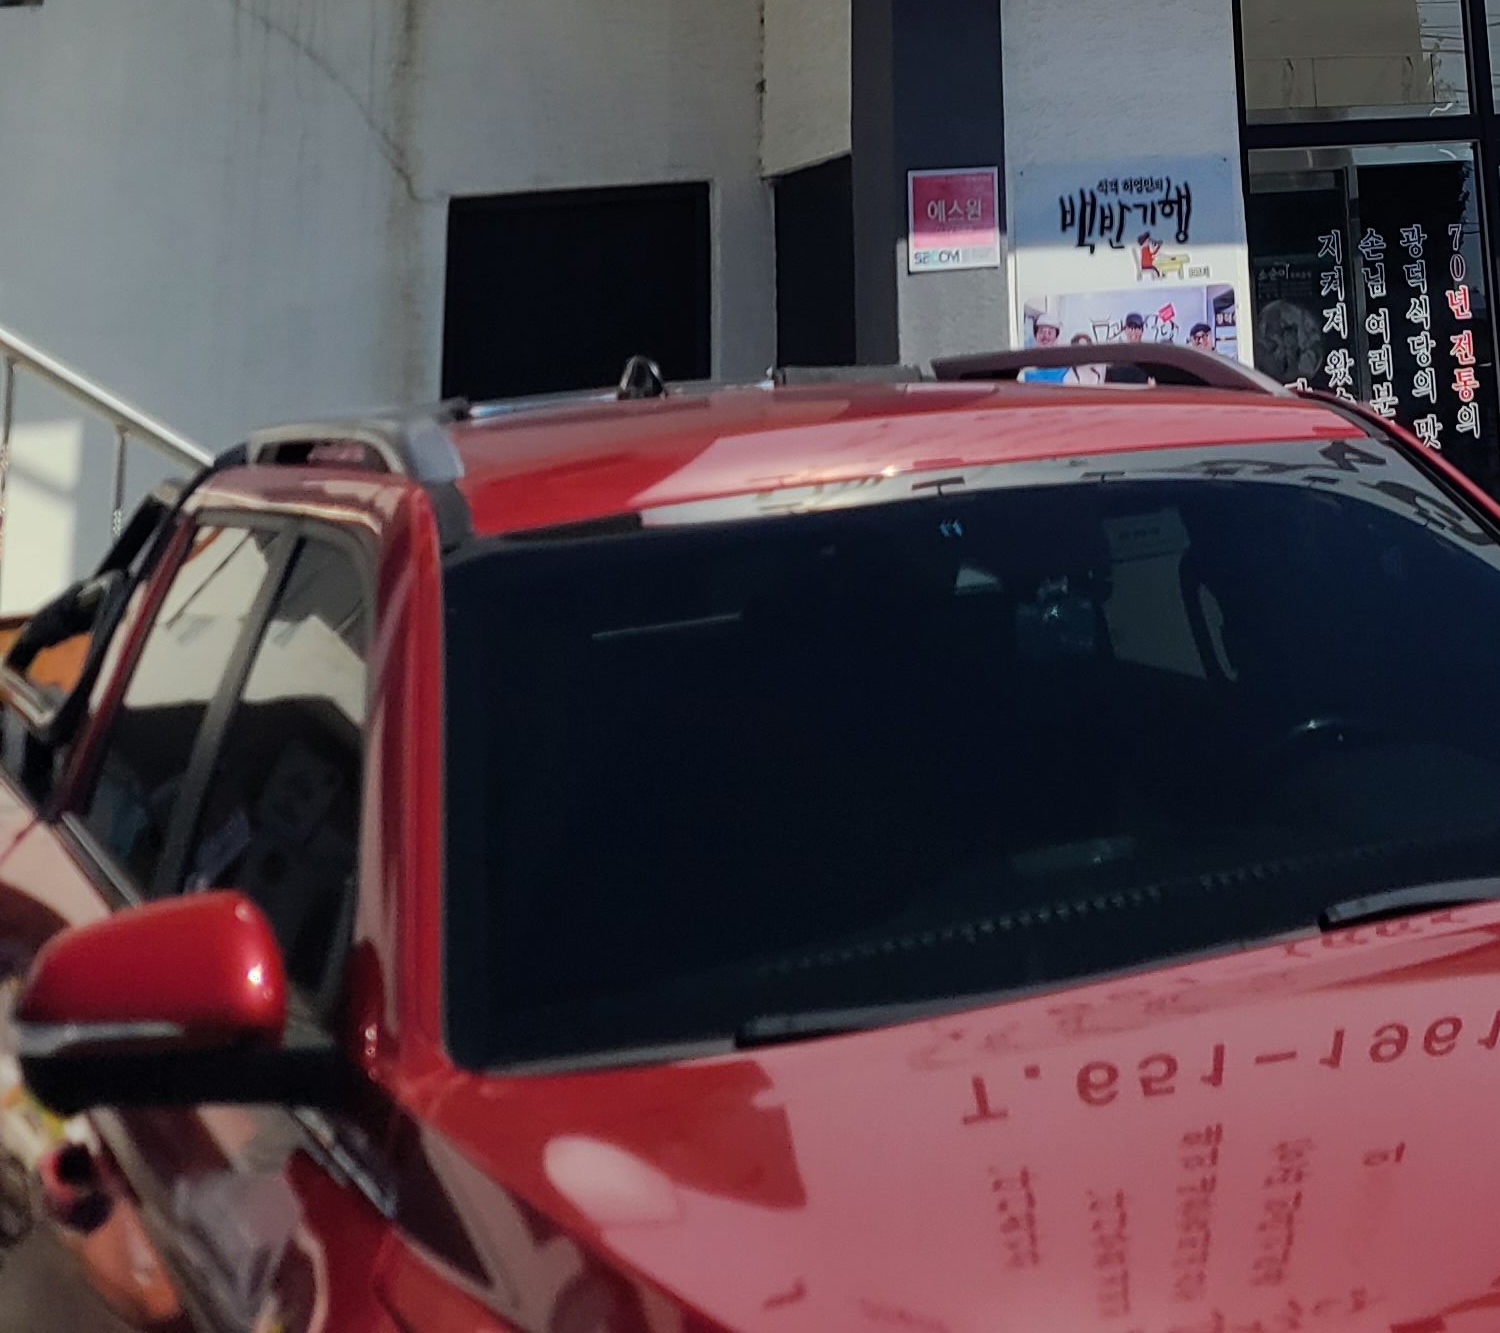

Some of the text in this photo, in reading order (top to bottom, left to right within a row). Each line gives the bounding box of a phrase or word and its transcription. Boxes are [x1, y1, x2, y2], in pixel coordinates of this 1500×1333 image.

[927, 196, 982, 223] 에스원
[1059, 175, 1191, 254] 백반기행
[1357, 228, 1386, 299] 손님
[1400, 223, 1437, 403] 광덕식당의
[1446, 224, 1480, 439] 70년 전통의
